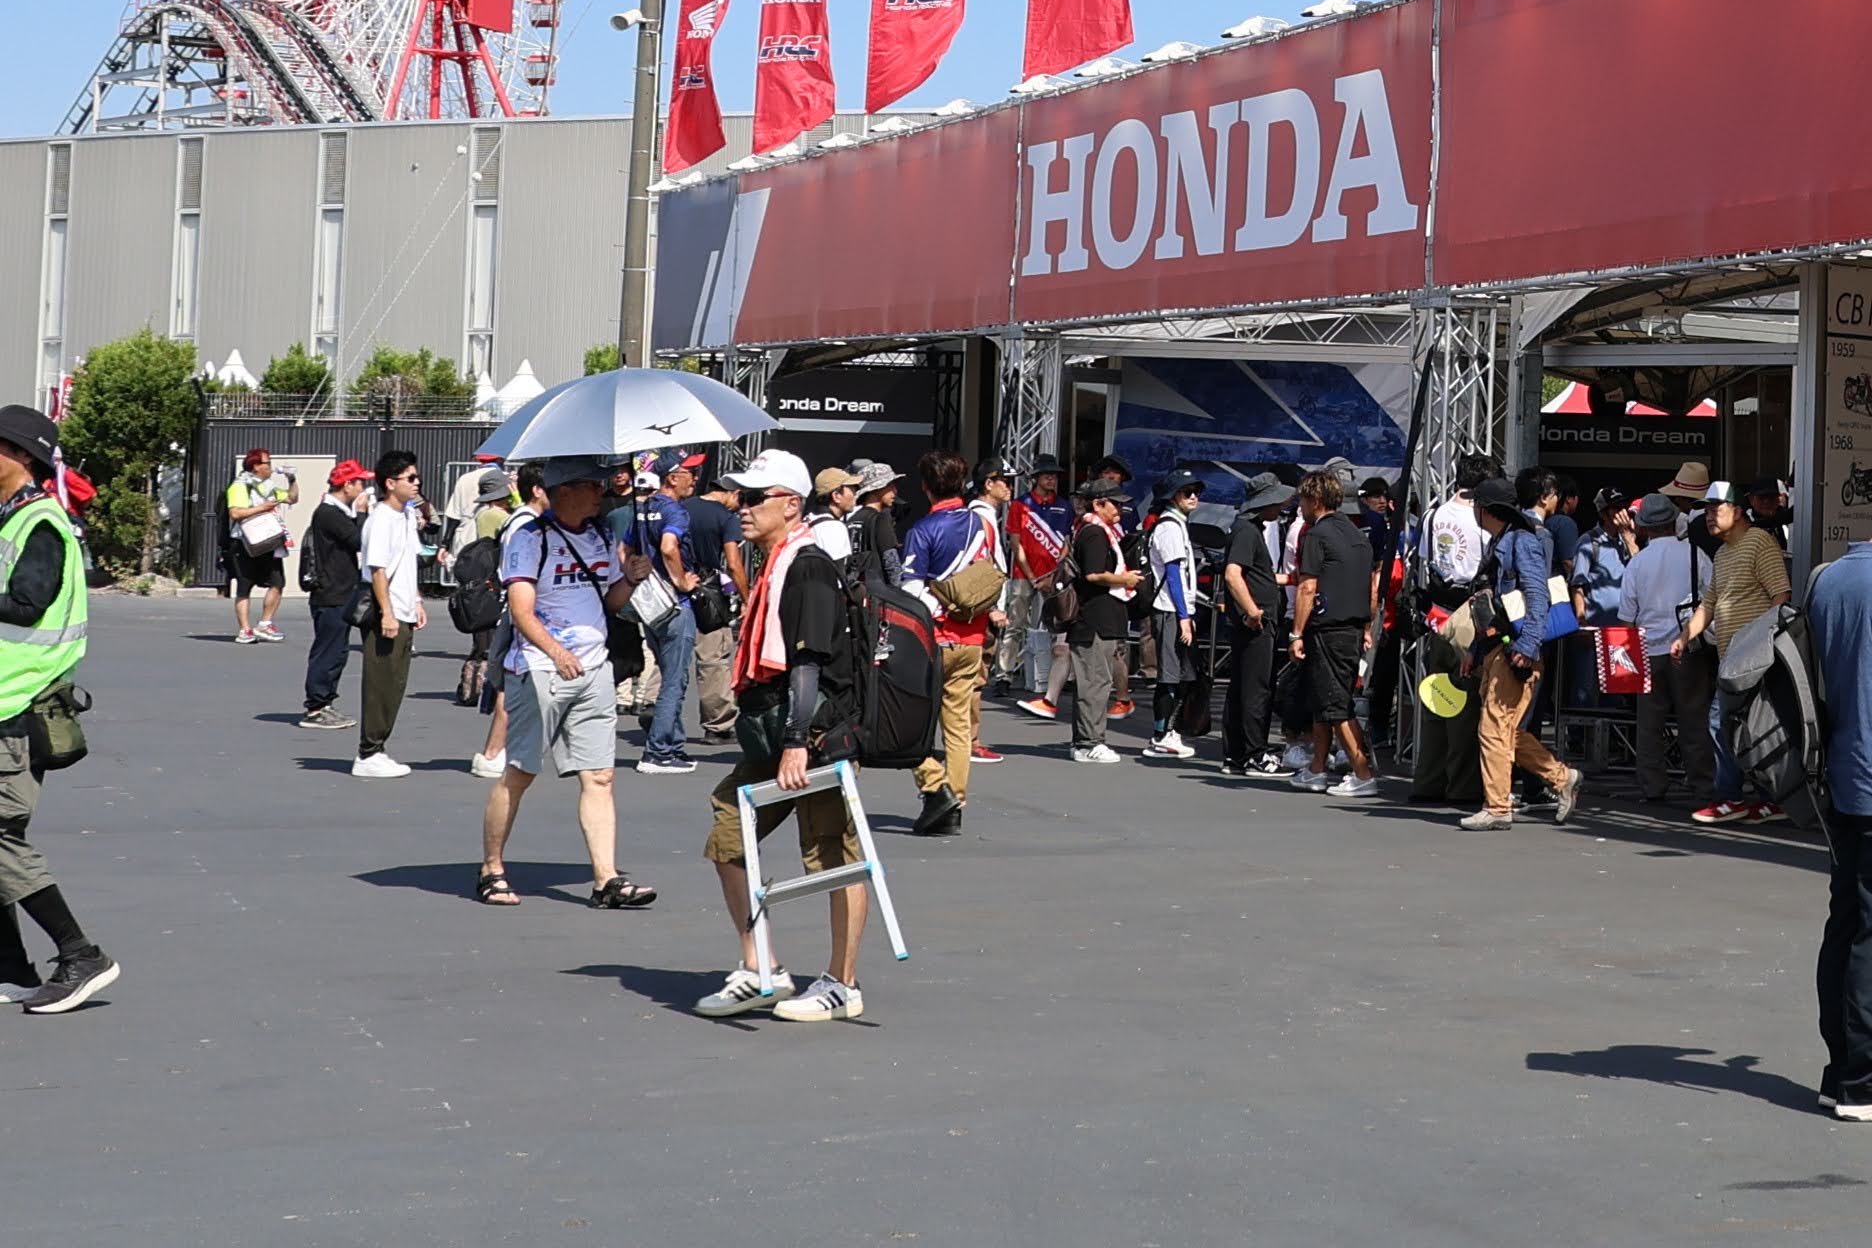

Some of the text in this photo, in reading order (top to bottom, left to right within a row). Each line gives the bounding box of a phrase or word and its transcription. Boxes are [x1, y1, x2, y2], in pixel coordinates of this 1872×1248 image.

[759, 35, 823, 59] HRC
[1022, 69, 1418, 276] HONDA
[1836, 293, 1864, 325] CB
[1831, 342, 1856, 357] 1959
[825, 398, 884, 413] Dream
[1619, 427, 1706, 444] Dream
[1830, 435, 1853, 450] 1968
[1024, 519, 1061, 560] HOND
[1828, 526, 1850, 541] 1971
